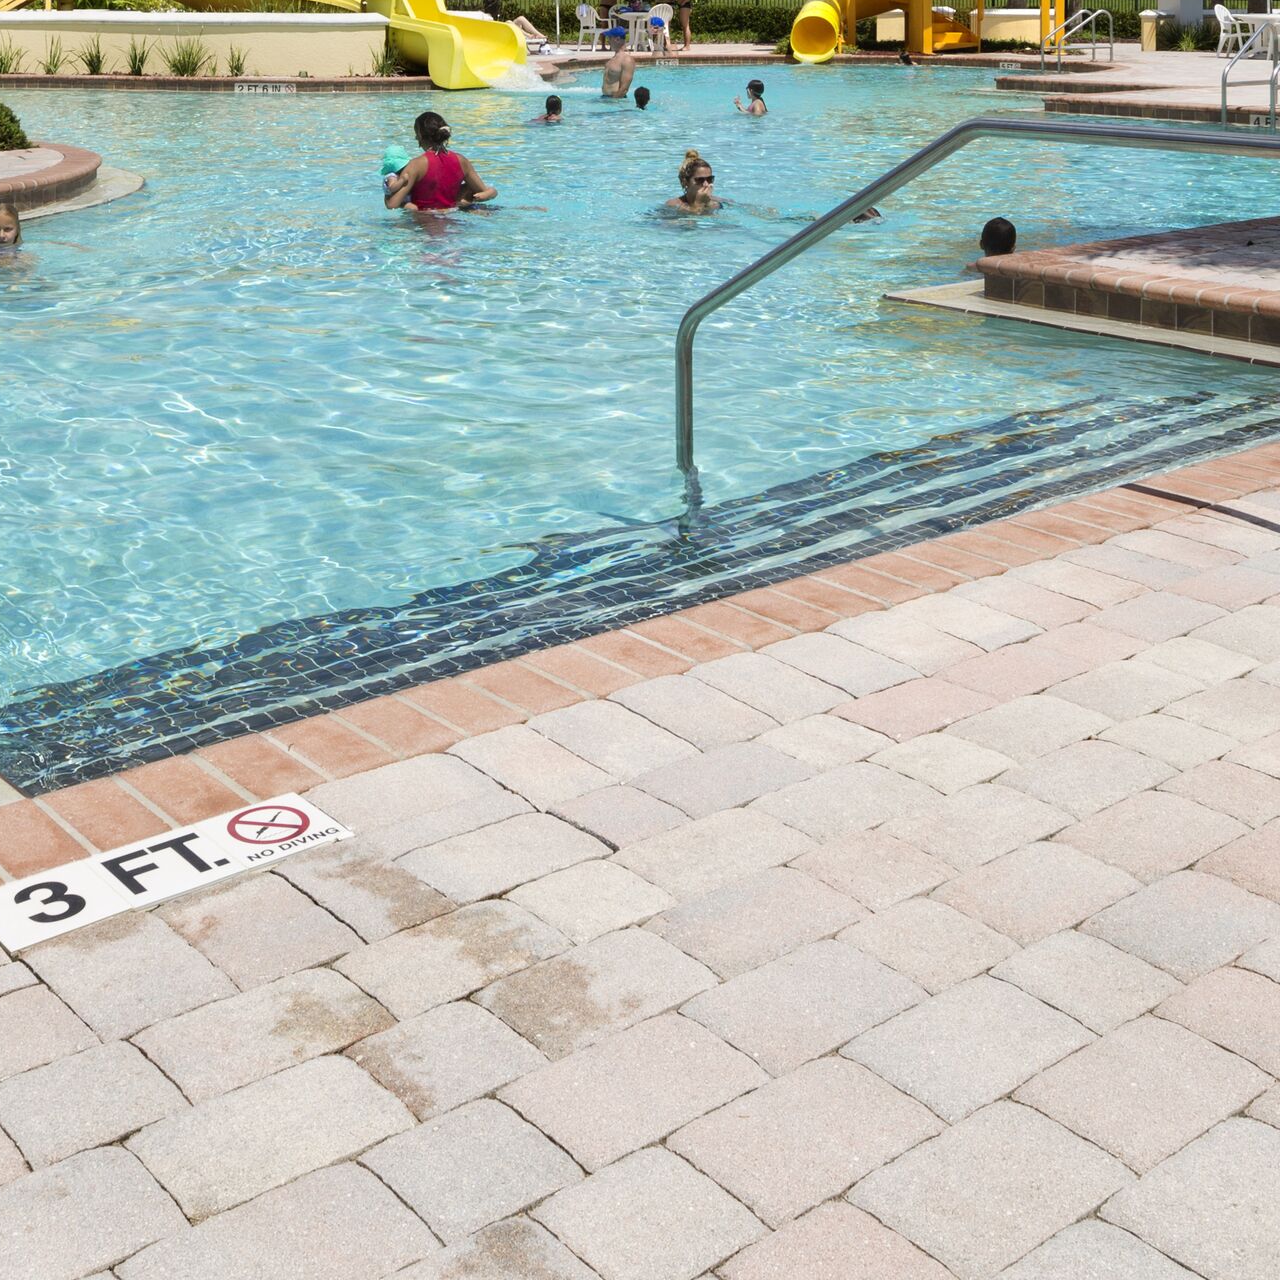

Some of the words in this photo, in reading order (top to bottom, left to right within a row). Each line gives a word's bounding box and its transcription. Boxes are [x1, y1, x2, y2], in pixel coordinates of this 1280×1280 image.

[247, 84, 259, 93] FT
[271, 84, 281, 93] IN
[1253, 116, 1260, 126] 4
[247, 849, 275, 862] NO
[278, 827, 340, 851] DIVING
[14, 881, 86, 923] 3
[100, 832, 231, 895] FT.
